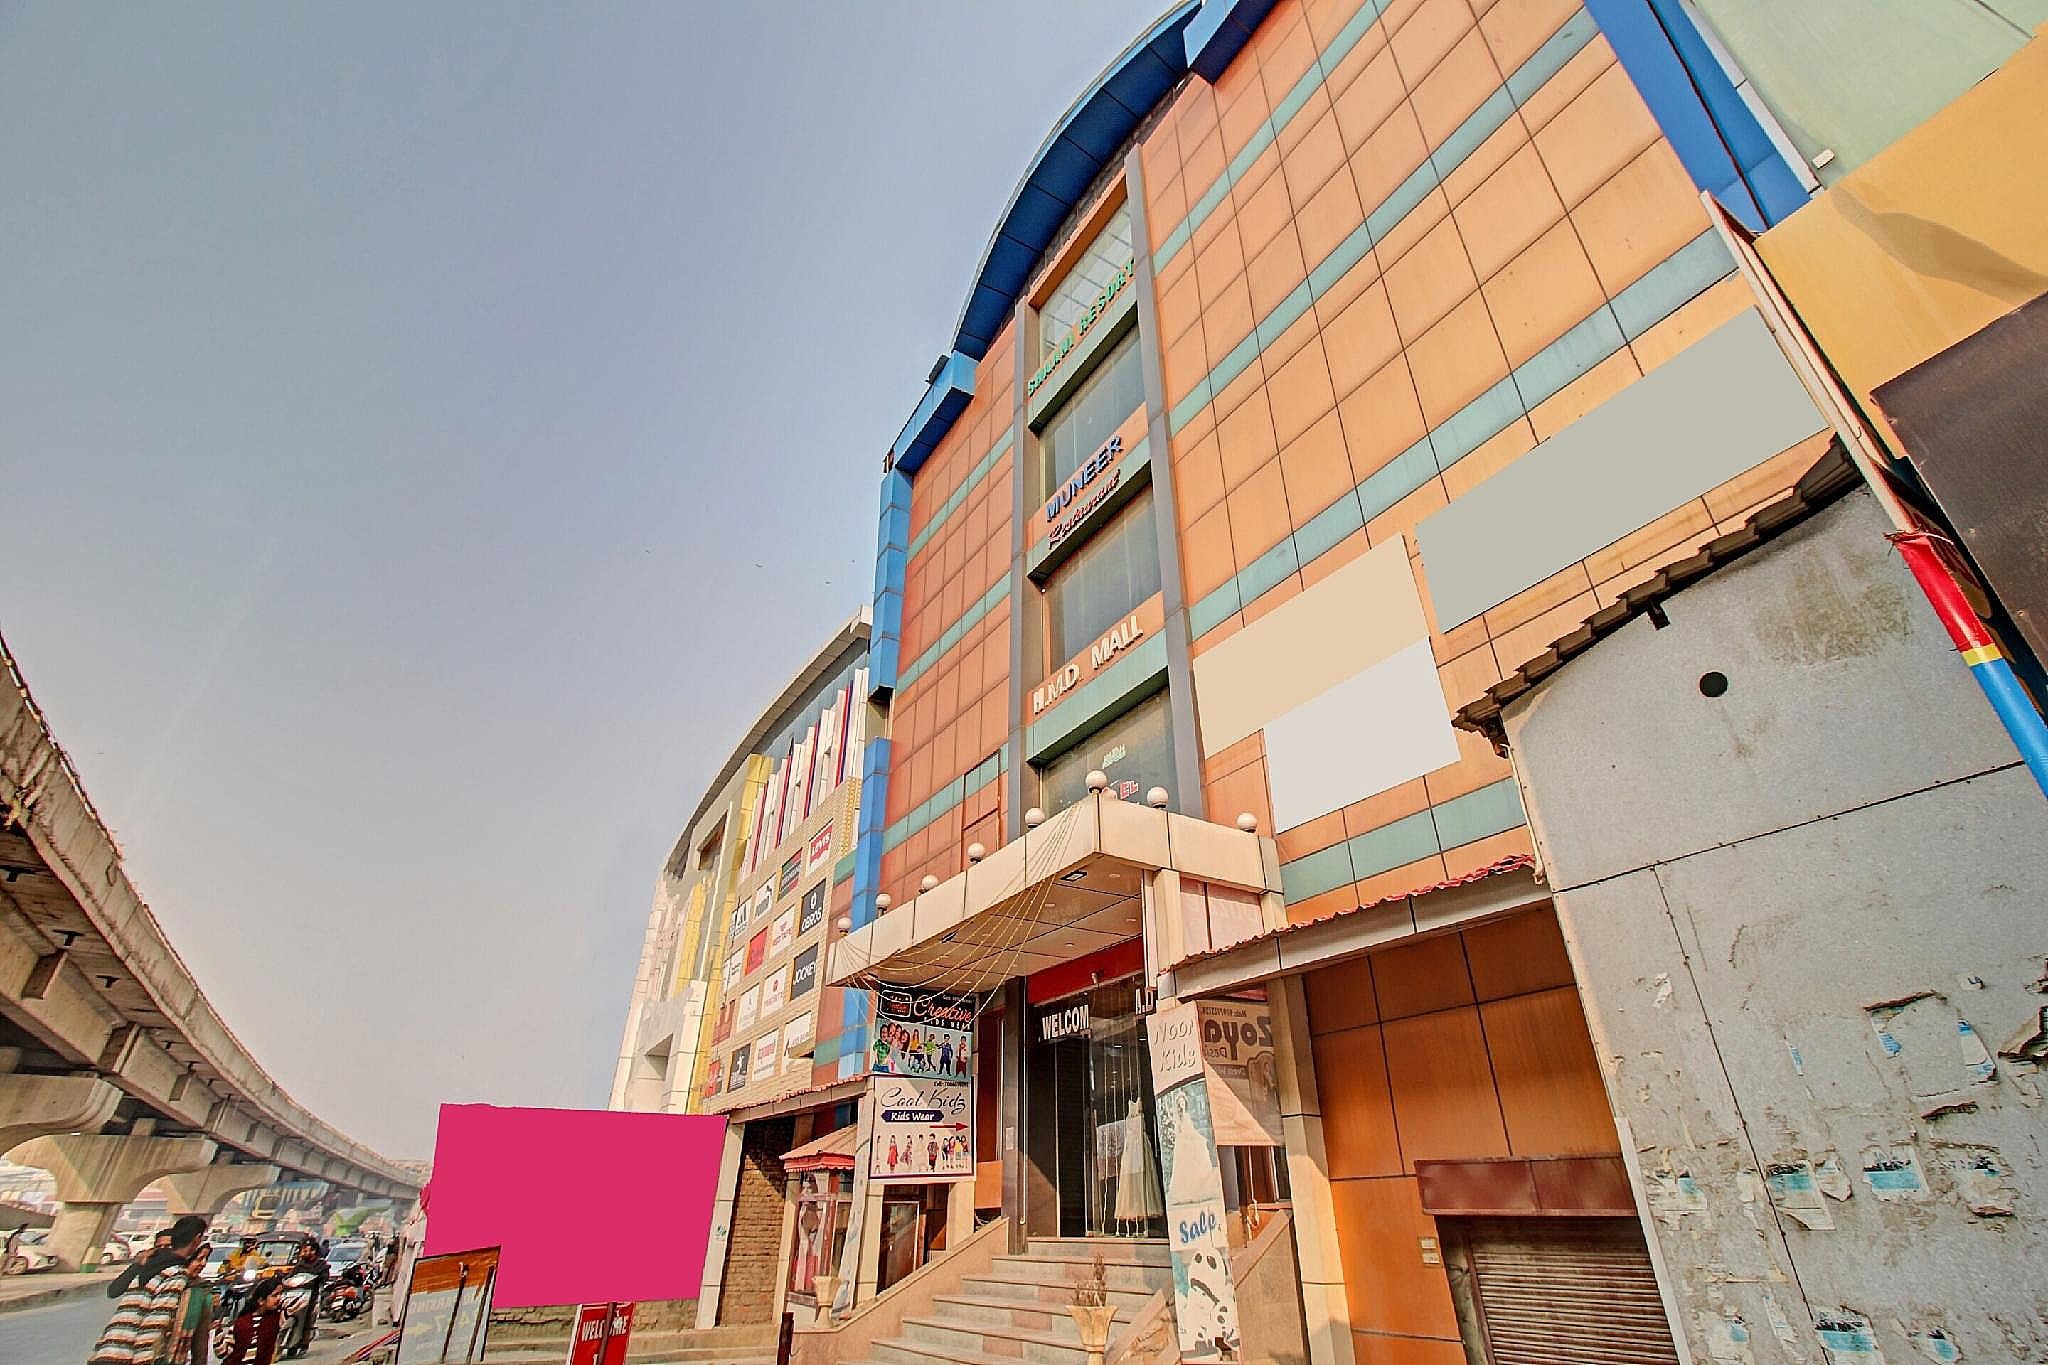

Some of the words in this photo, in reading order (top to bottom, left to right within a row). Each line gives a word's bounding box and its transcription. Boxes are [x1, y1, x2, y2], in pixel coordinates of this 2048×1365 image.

[1079, 257, 1135, 337] RESORT
[1045, 435, 1123, 523] MUNEER
[1091, 615, 1144, 671] MALL
[913, 994, 972, 1023] Creative
[1041, 1004, 1089, 1040] WELCOM
[890, 1111, 910, 1121] Kids
[911, 1111, 935, 1121] Wear
